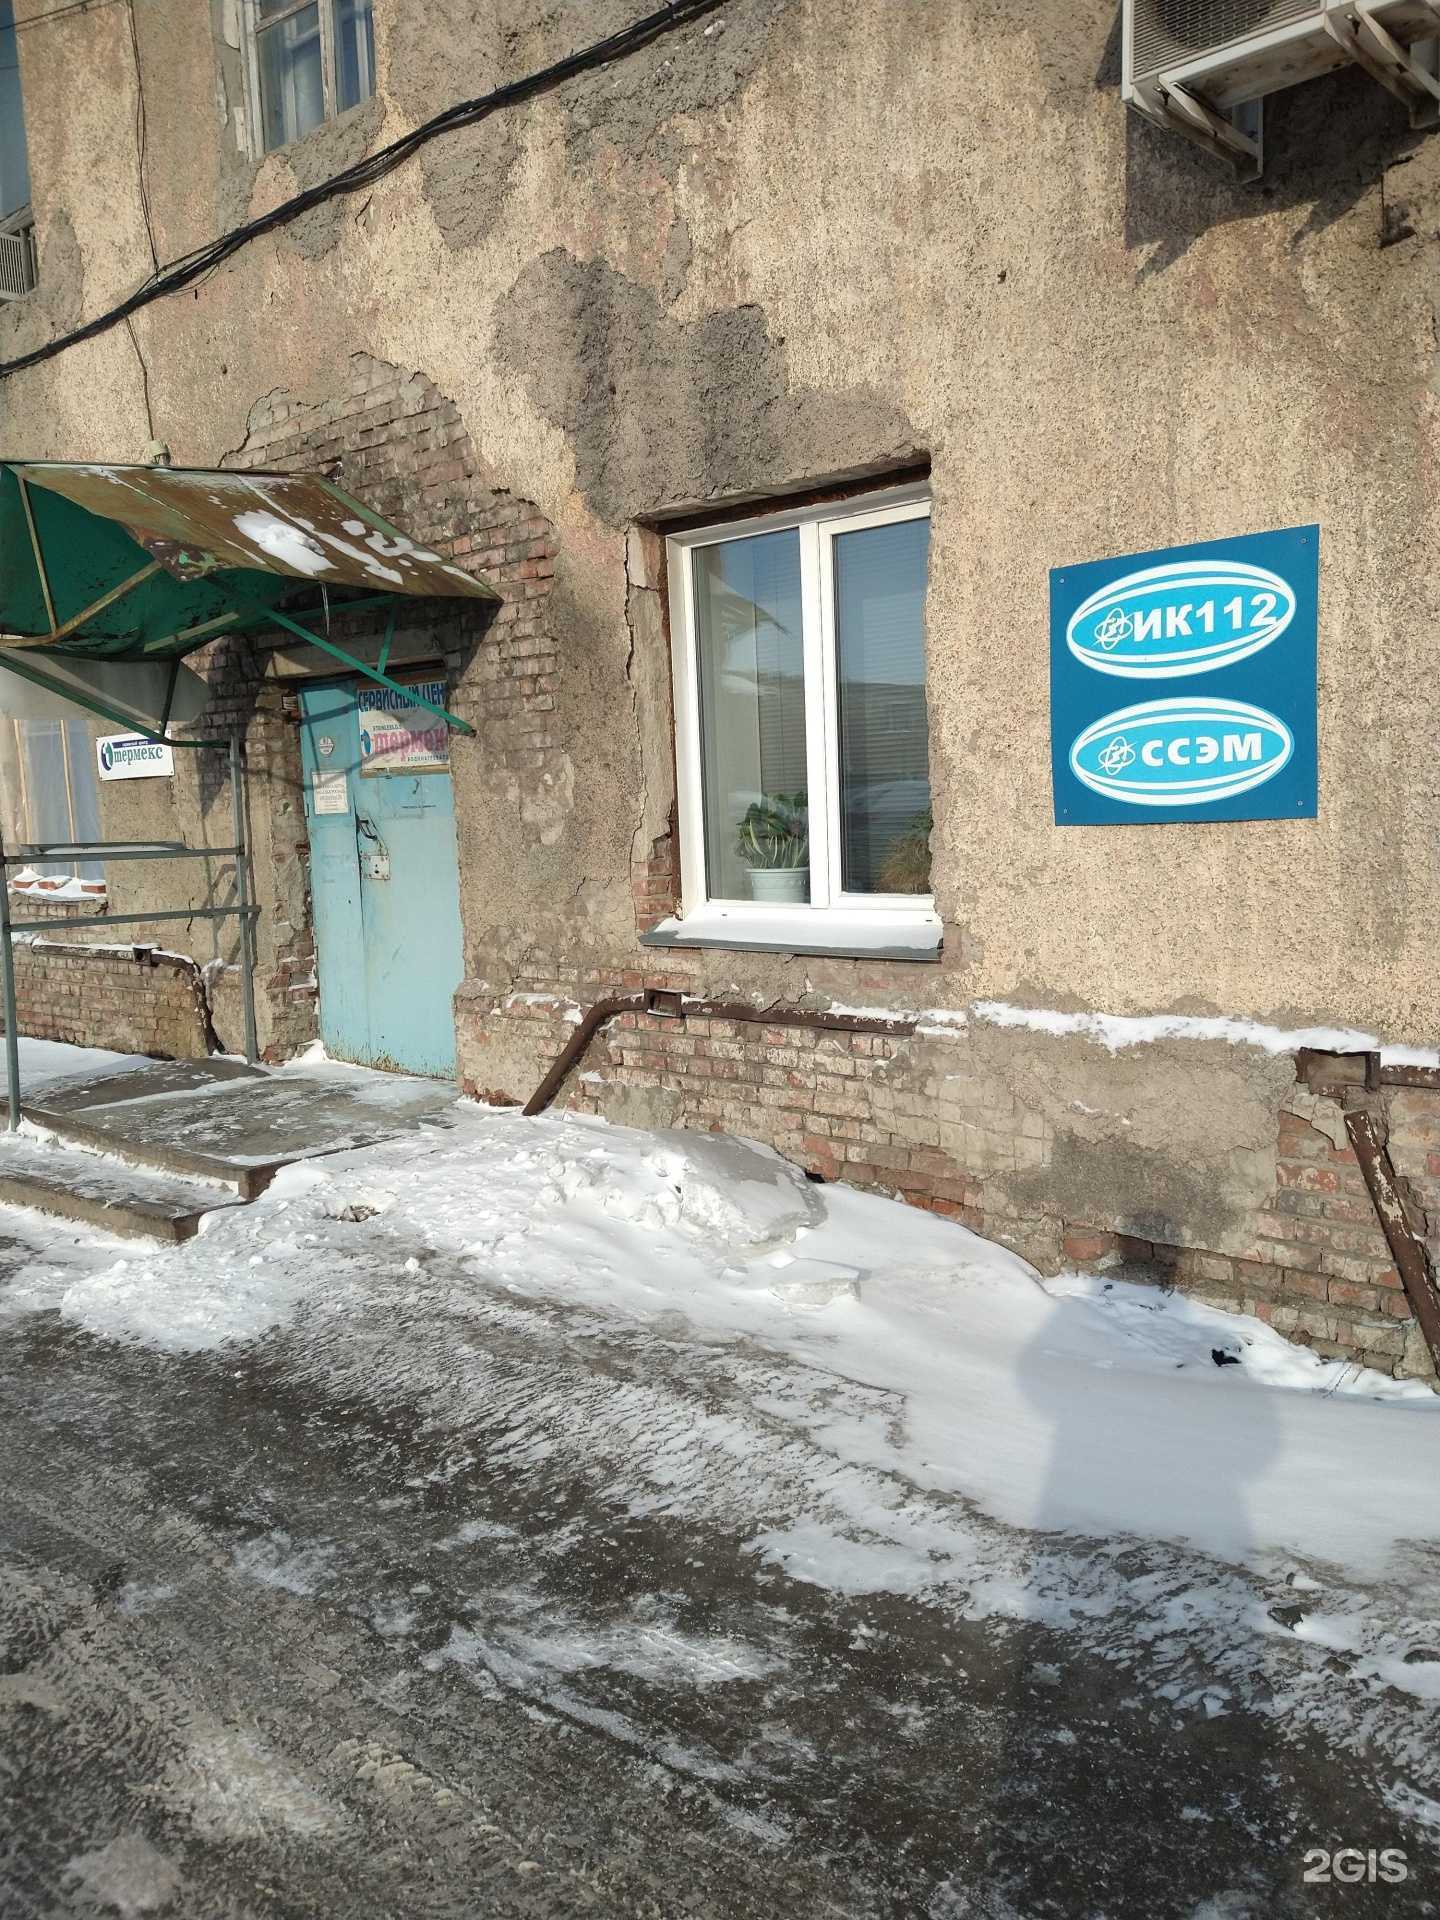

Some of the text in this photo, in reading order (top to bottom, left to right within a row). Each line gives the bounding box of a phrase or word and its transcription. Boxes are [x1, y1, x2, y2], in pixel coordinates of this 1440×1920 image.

[1133, 592, 1278, 642] ИК112
[113, 746, 164, 766] термекс
[1141, 732, 1263, 767] ССЭМ
